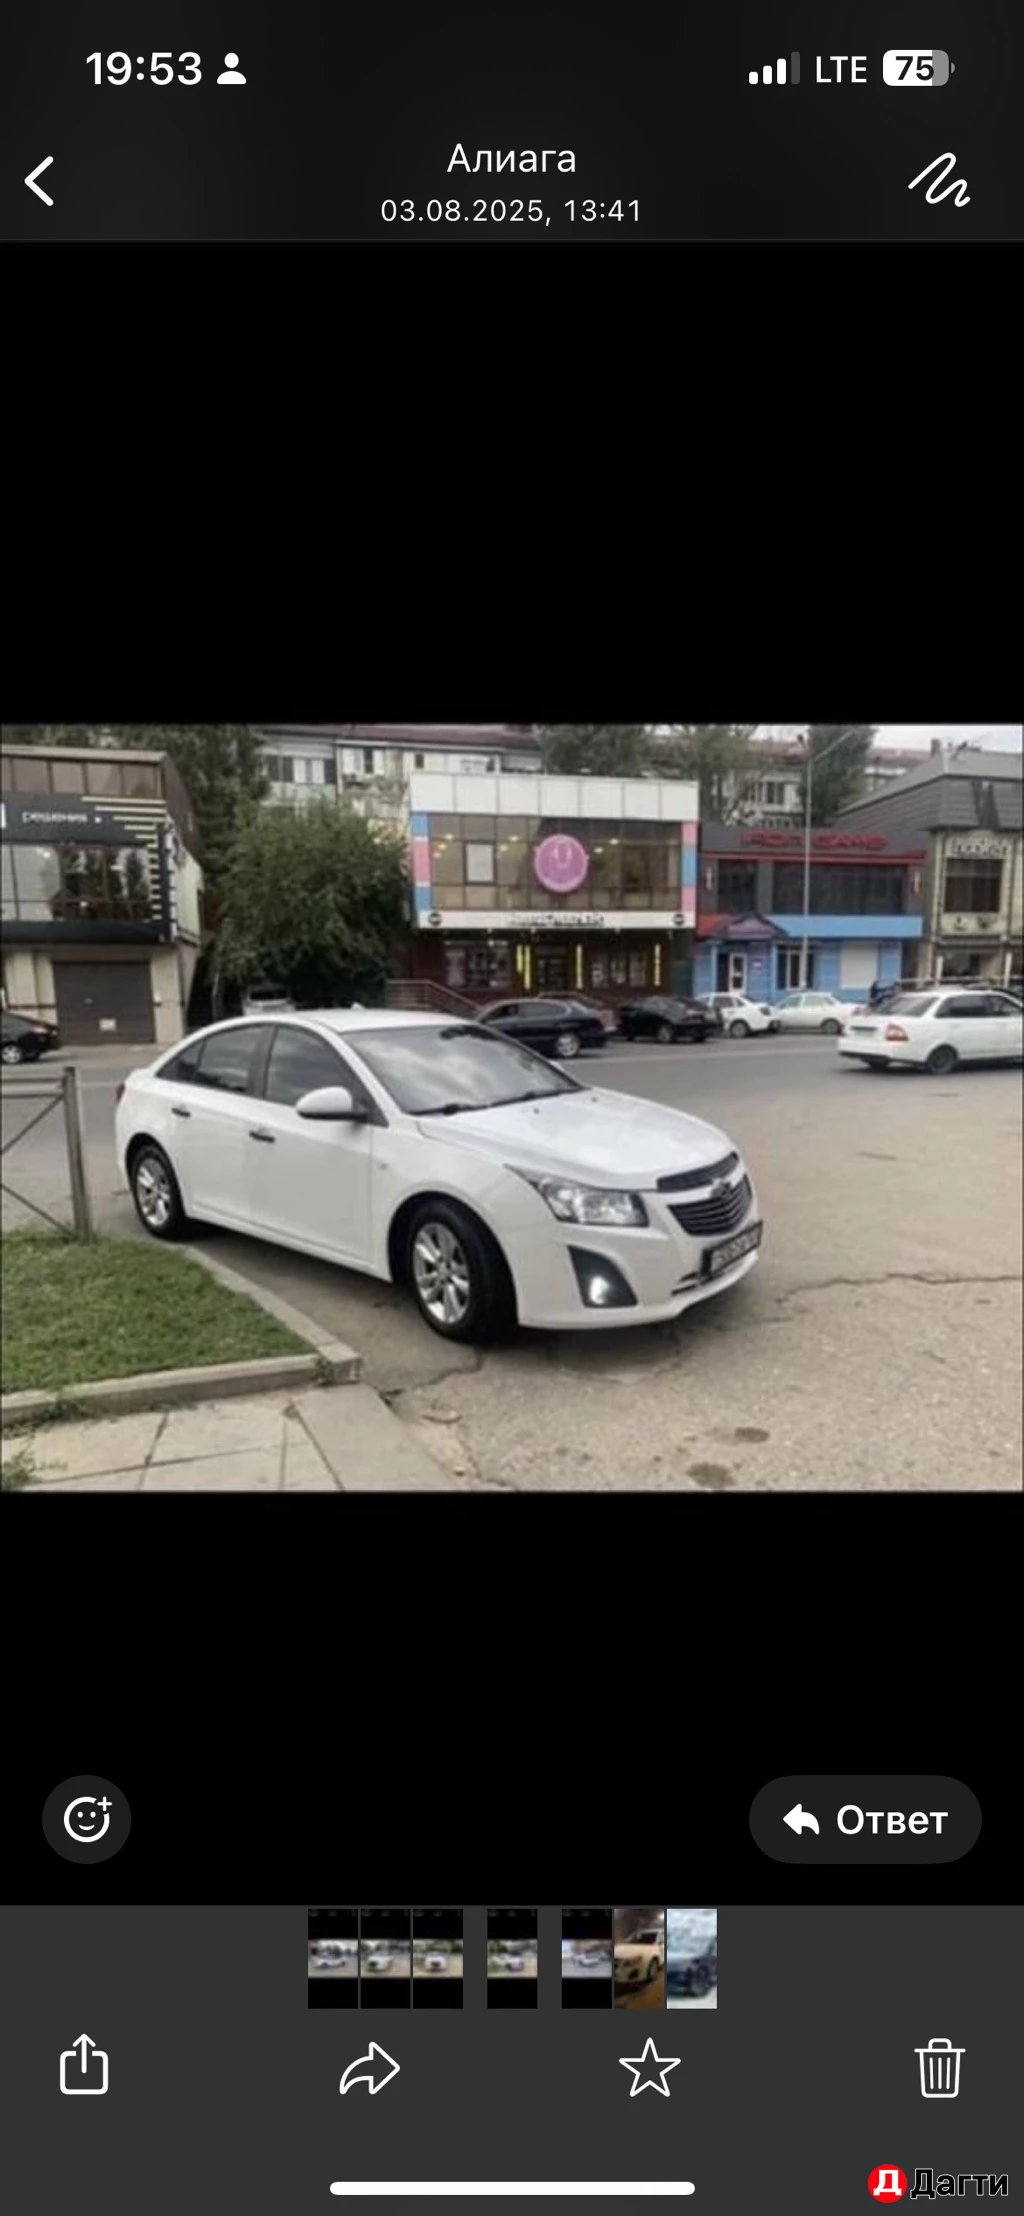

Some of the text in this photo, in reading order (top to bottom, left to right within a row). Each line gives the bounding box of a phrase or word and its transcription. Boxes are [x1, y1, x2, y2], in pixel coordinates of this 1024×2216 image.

[86, 51, 202, 86] 19:53
[816, 55, 867, 83] LTE
[895, 55, 935, 82] 75
[446, 143, 577, 174] Алиага
[381, 199, 641, 227] 03.08.2025, 13:41
[836, 1804, 949, 1835] Ответ
